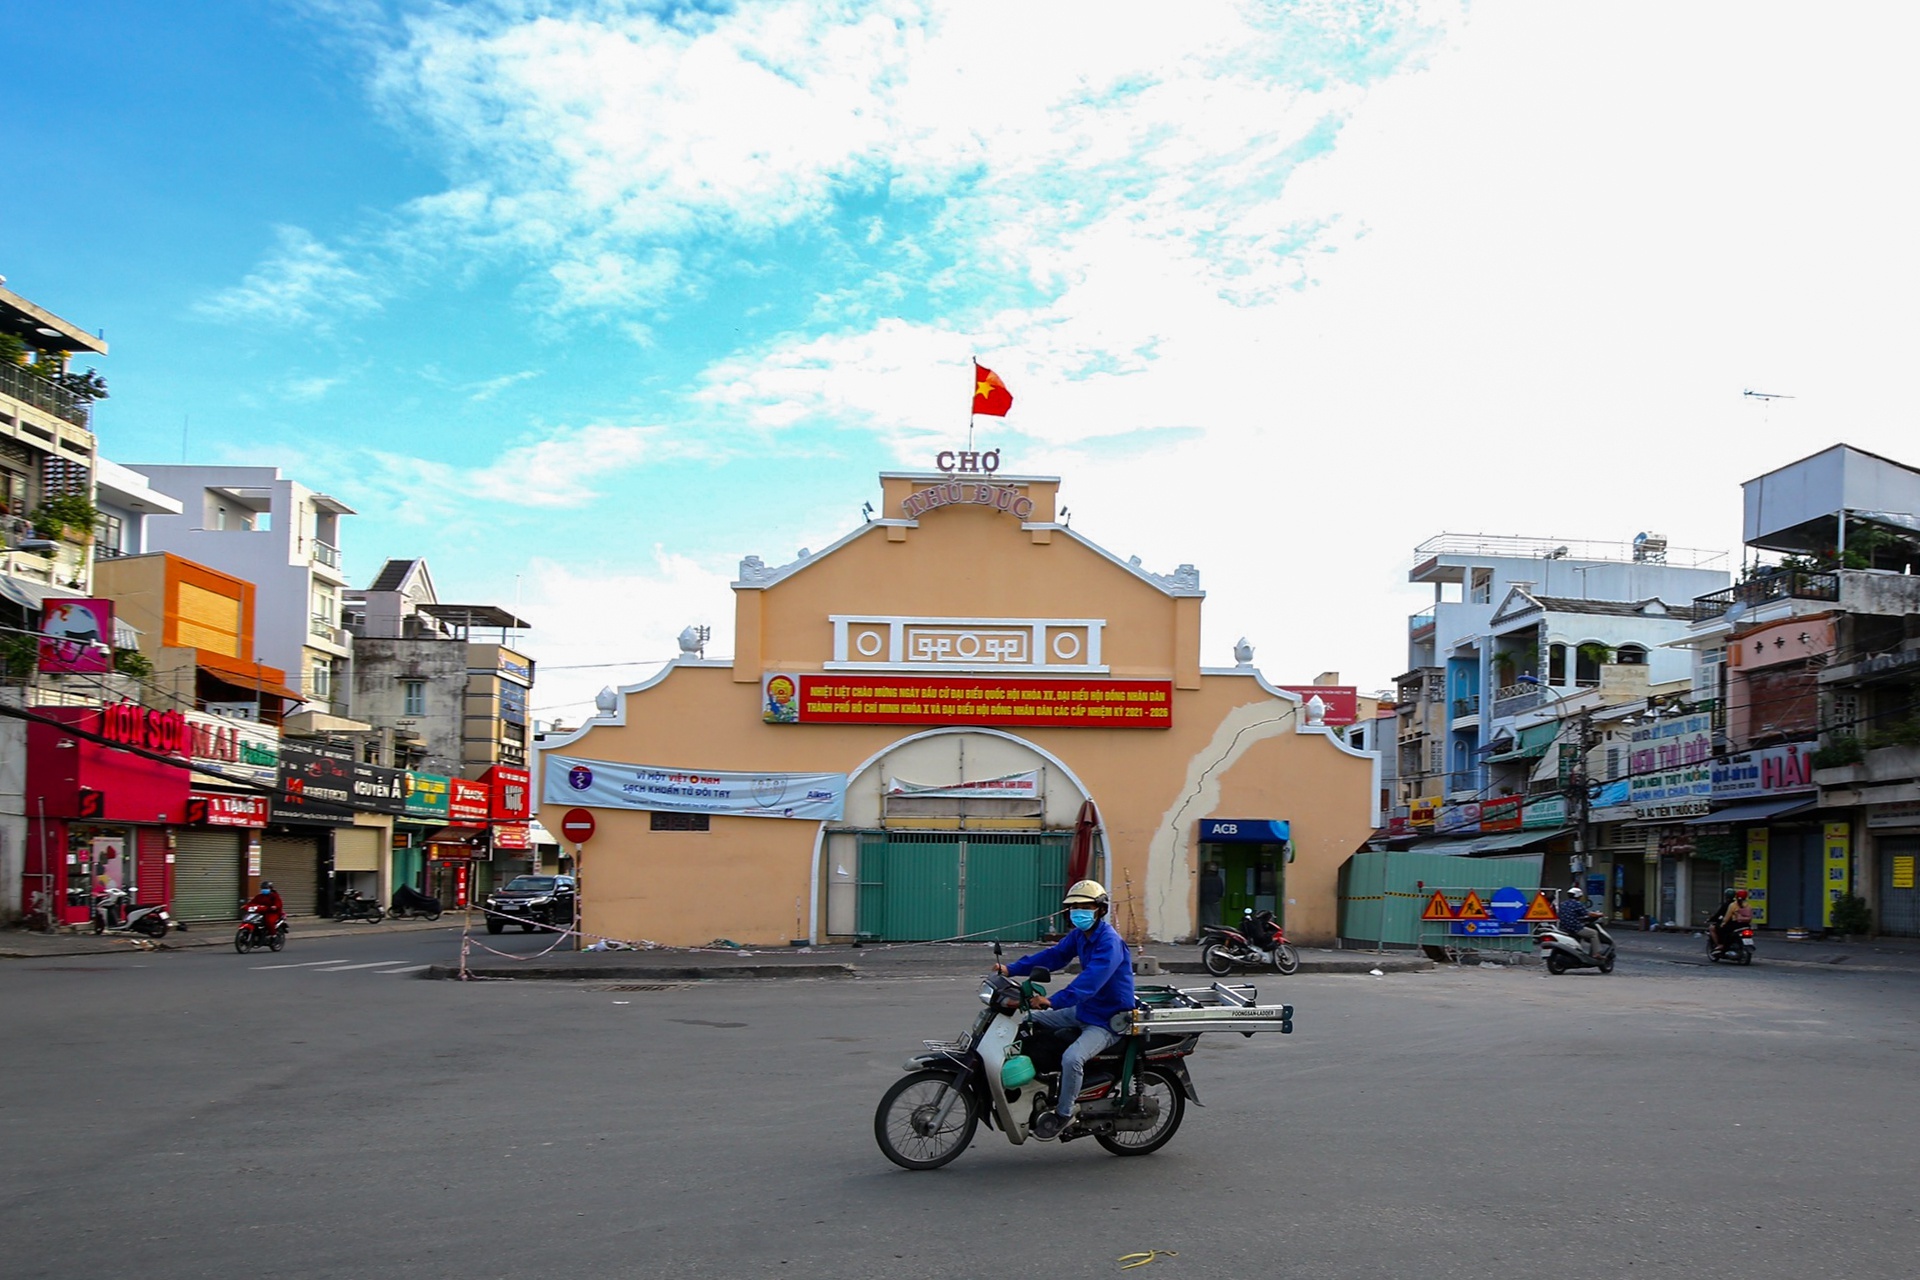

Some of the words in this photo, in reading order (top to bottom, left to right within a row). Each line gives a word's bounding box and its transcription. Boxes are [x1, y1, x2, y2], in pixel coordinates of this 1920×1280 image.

[937, 448, 1000, 475] CHỢ
[902, 475, 963, 516] THỦ
[974, 484, 1033, 518] ĐỨC
[810, 685, 833, 698] NHIỆT
[834, 685, 851, 699] LIỆT
[852, 686, 873, 698] CHÀO
[874, 686, 898, 698] MỪNG
[899, 686, 920, 698] NGÀY
[921, 686, 937, 699] BẦU
[939, 686, 950, 699] CỬ
[951, 688, 964, 701] ĐẠI
[965, 686, 983, 699] BIỂU
[984, 687, 1005, 700] QUỐC
[1007, 688, 1020, 702] HỘI
[1057, 690, 1070, 702] ĐẠI
[1071, 687, 1089, 701] BIỂU
[1090, 689, 1103, 702] HỘI
[1105, 689, 1126, 701] ĐỒNG
[1127, 689, 1148, 701] NHÂN
[1149, 690, 1166, 701] DÂN
[807, 701, 833, 712] THÀNH
[834, 700, 850, 713] PHỐ
[851, 700, 862, 713] HỒ
[864, 702, 877, 713] CHÍ
[878, 703, 900, 713] MINH
[923, 704, 930, 714] X
[930, 703, 941, 714] VÀ
[942, 704, 956, 716] ĐẠI
[957, 702, 975, 715] BIỂU
[976, 704, 989, 717] HỘI
[991, 703, 1012, 715] ĐỒNG
[1013, 704, 1035, 715] NHÂN
[1036, 704, 1053, 715] DÂN
[1054, 705, 1070, 716] CÁC
[1071, 704, 1086, 716] CẤP
[1088, 705, 1113, 718] NHIỆM
[1125, 707, 1143, 717] 2021
[1150, 707, 1169, 717] 2026
[190, 721, 239, 762] MAI
[1762, 747, 1811, 789] HẢI
[647, 773, 666, 783] MỘT
[668, 773, 688, 785] VIỆT
[623, 784, 646, 794] SẠCH
[713, 790, 731, 798] TAY
[211, 798, 220, 811] 1
[222, 798, 255, 814] TẶNG
[257, 803, 264, 814] 1
[1212, 824, 1238, 834] ACB
